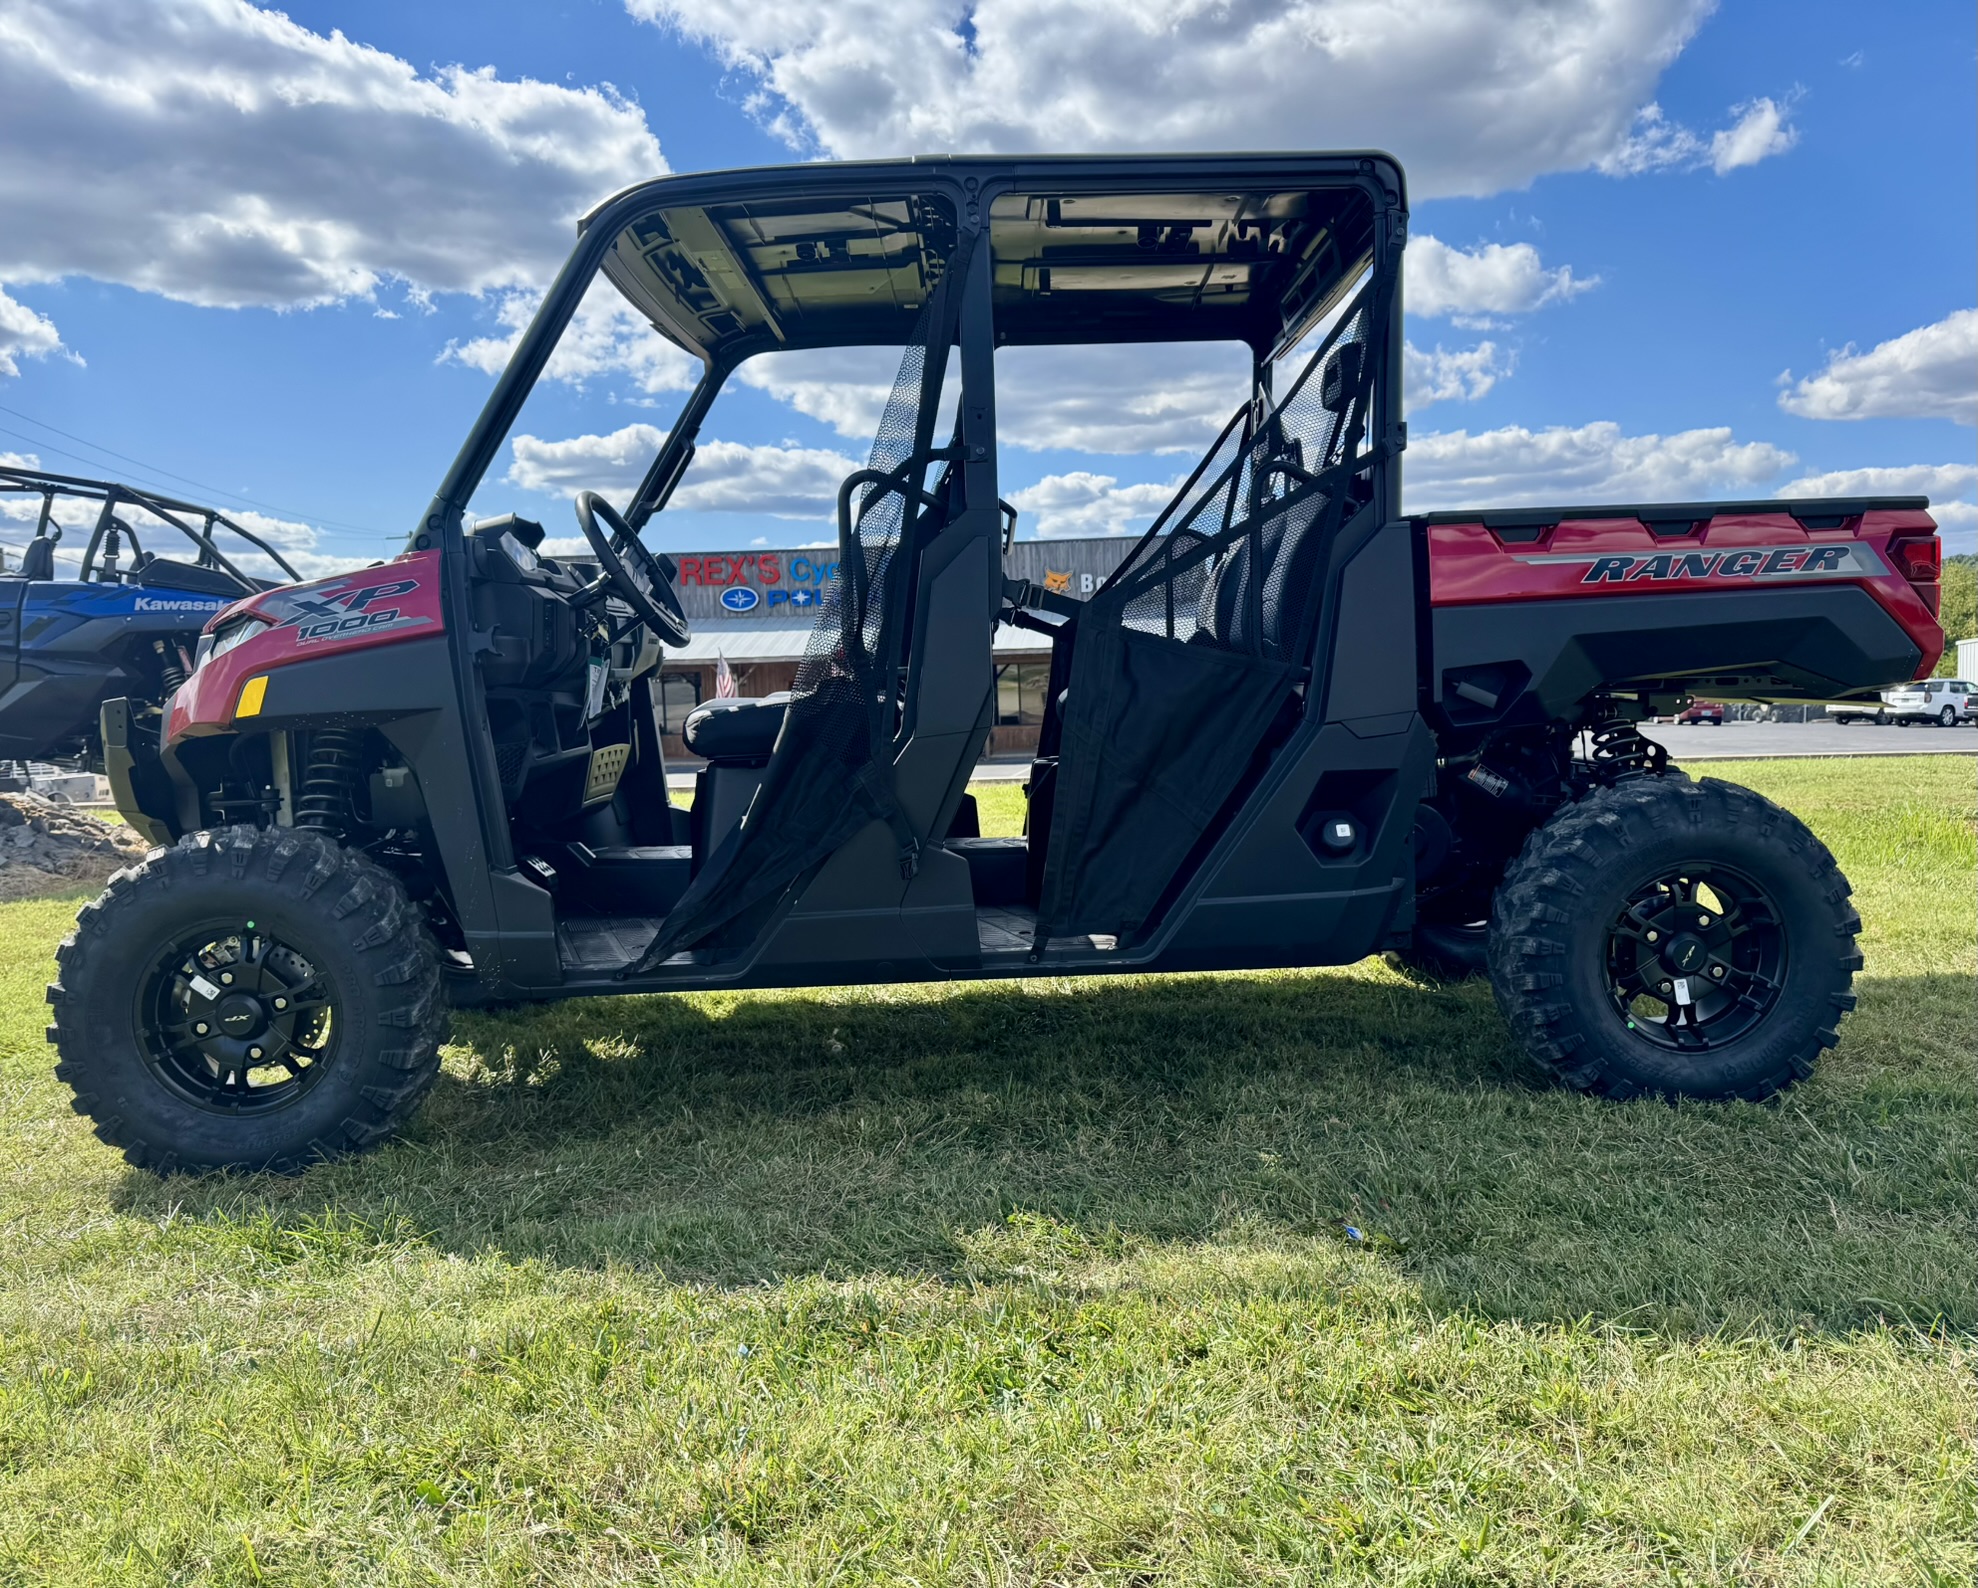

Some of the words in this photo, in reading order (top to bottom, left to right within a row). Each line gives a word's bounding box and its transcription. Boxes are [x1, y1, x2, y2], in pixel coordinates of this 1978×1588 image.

[679, 553, 782, 586] REX'S
[1580, 545, 1851, 583] RANGER
[270, 578, 420, 630] XP
[296, 607, 400, 642] 1000
[296, 638, 320, 647] DUAL
[321, 627, 371, 642] OVERHEAD
[372, 623, 394, 632] CAM
